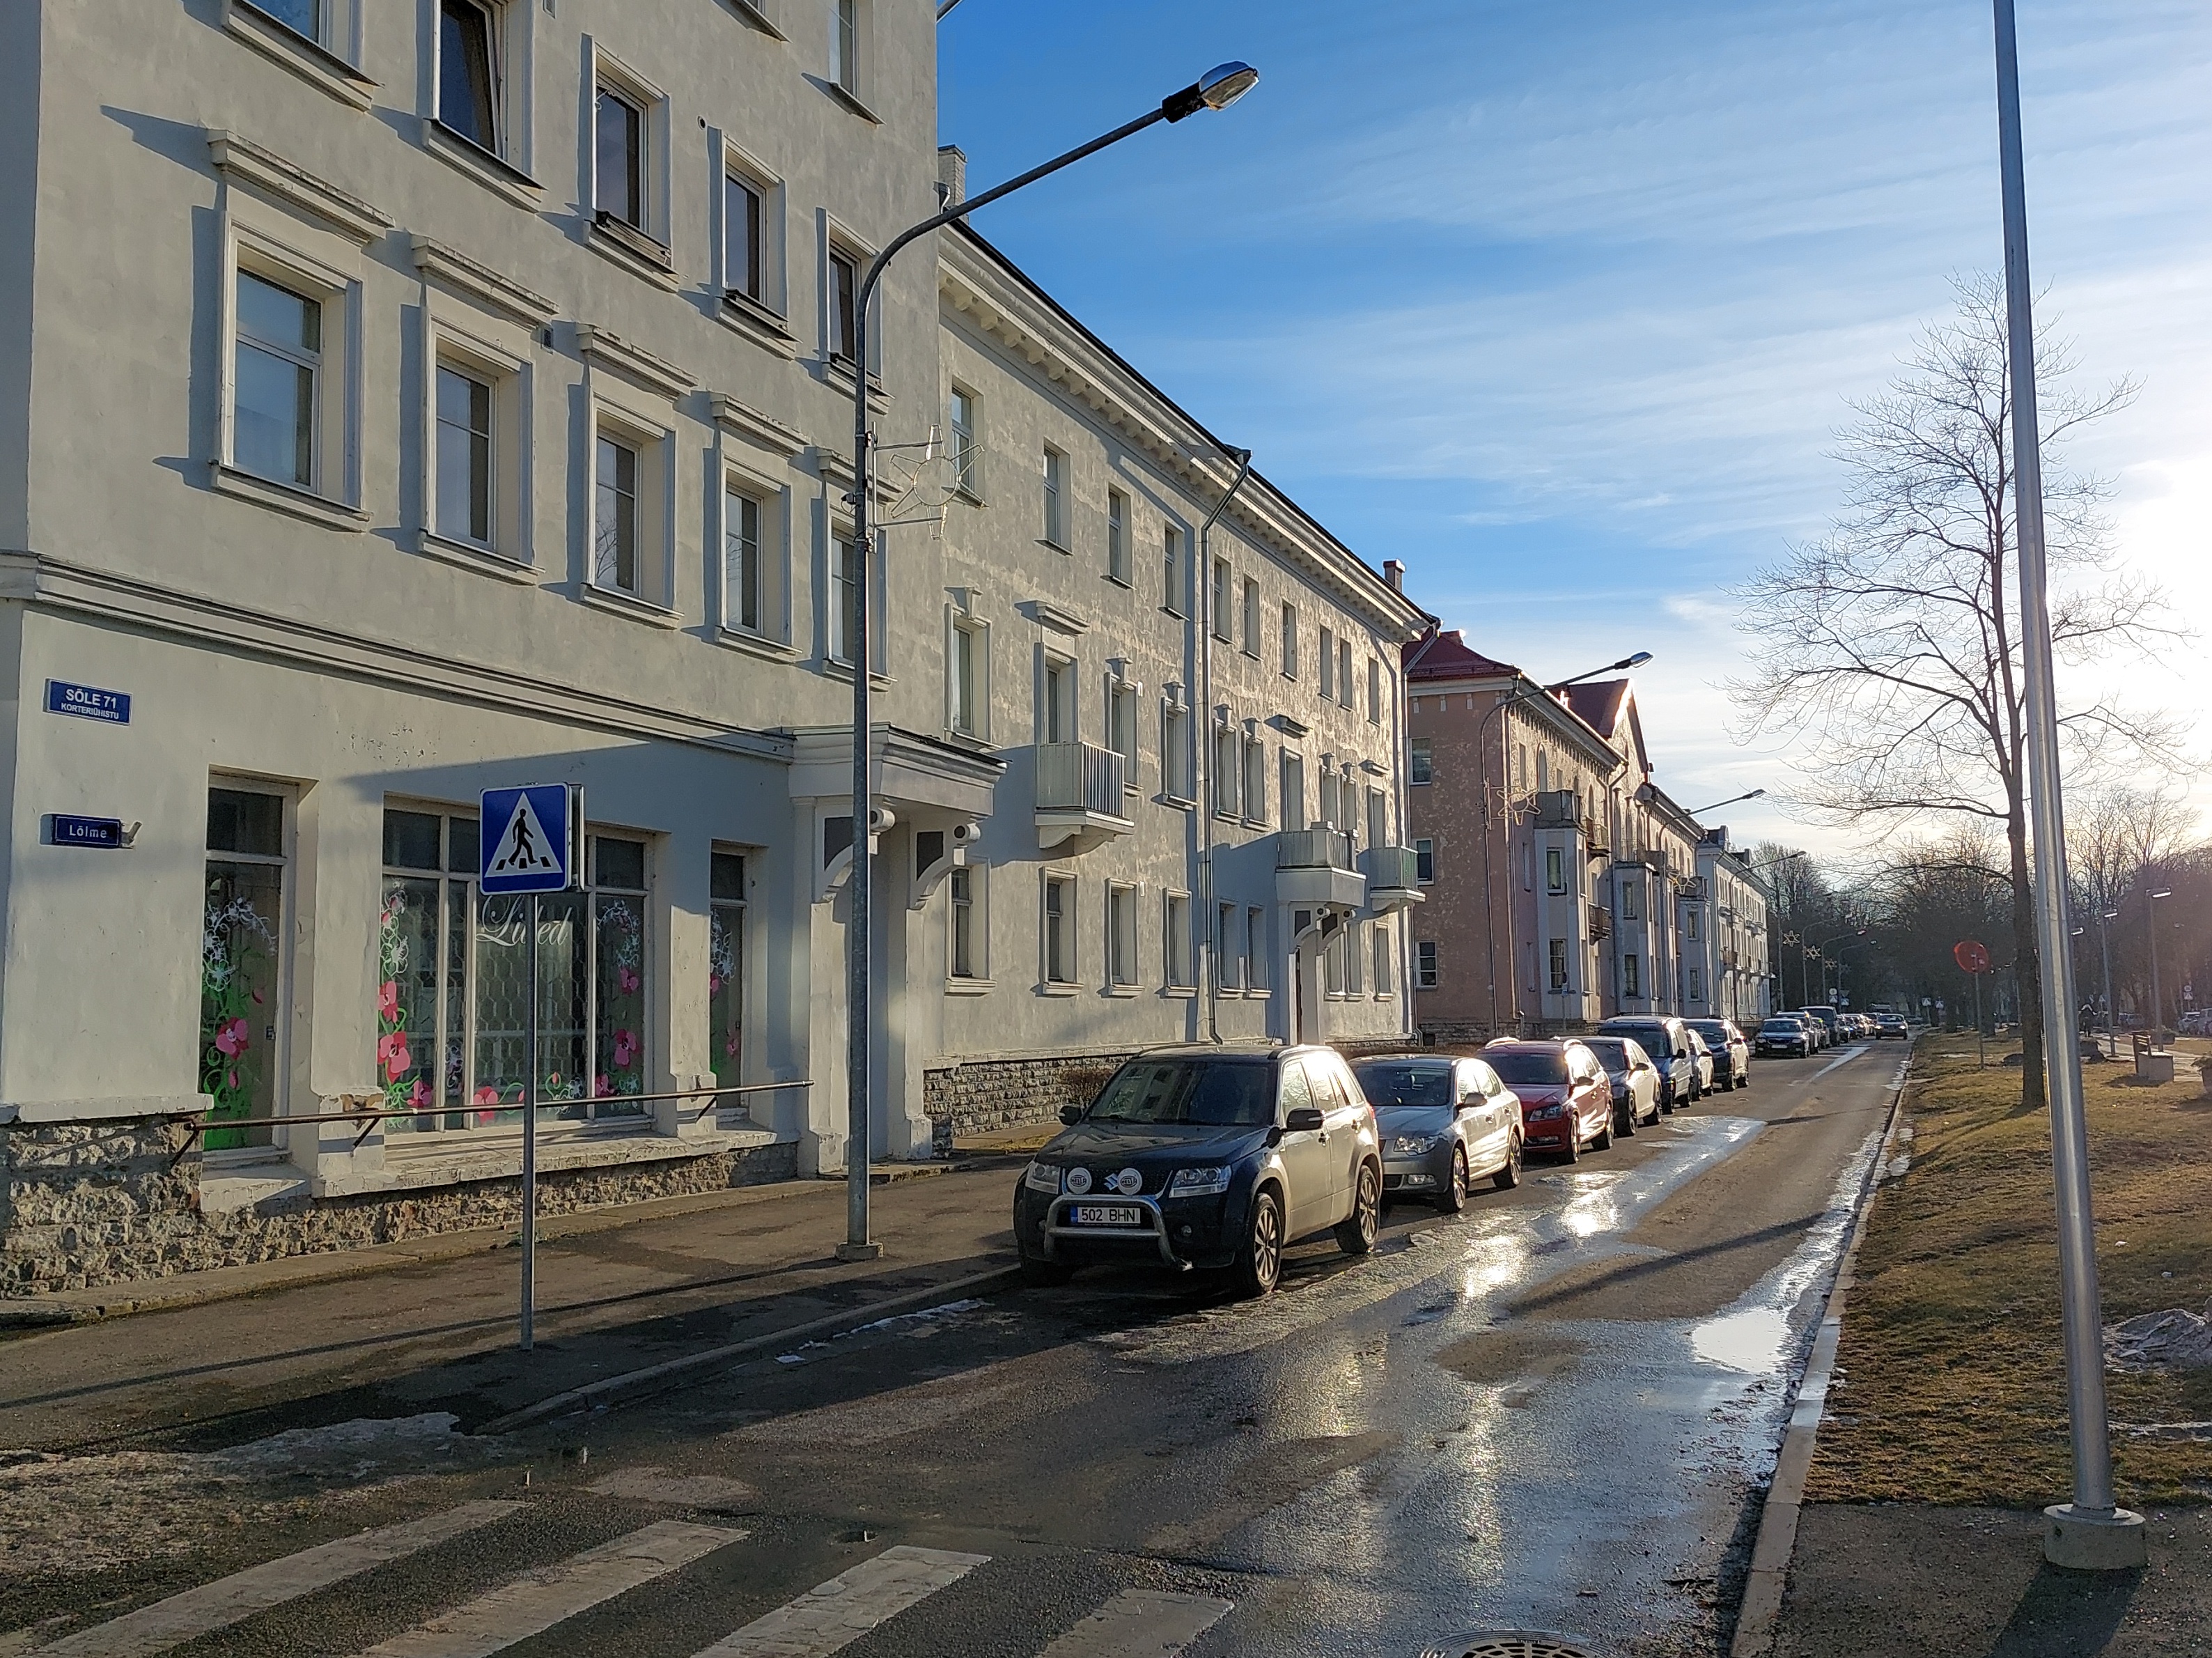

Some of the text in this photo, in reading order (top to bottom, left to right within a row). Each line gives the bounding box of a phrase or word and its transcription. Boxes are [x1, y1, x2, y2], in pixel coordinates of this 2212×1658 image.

[65, 688, 116, 709] SÕLE 71
[61, 702, 119, 719] KORTERIÜHISTU
[1081, 1208, 1103, 1222] 502
[1109, 1209, 1135, 1223] BHN
